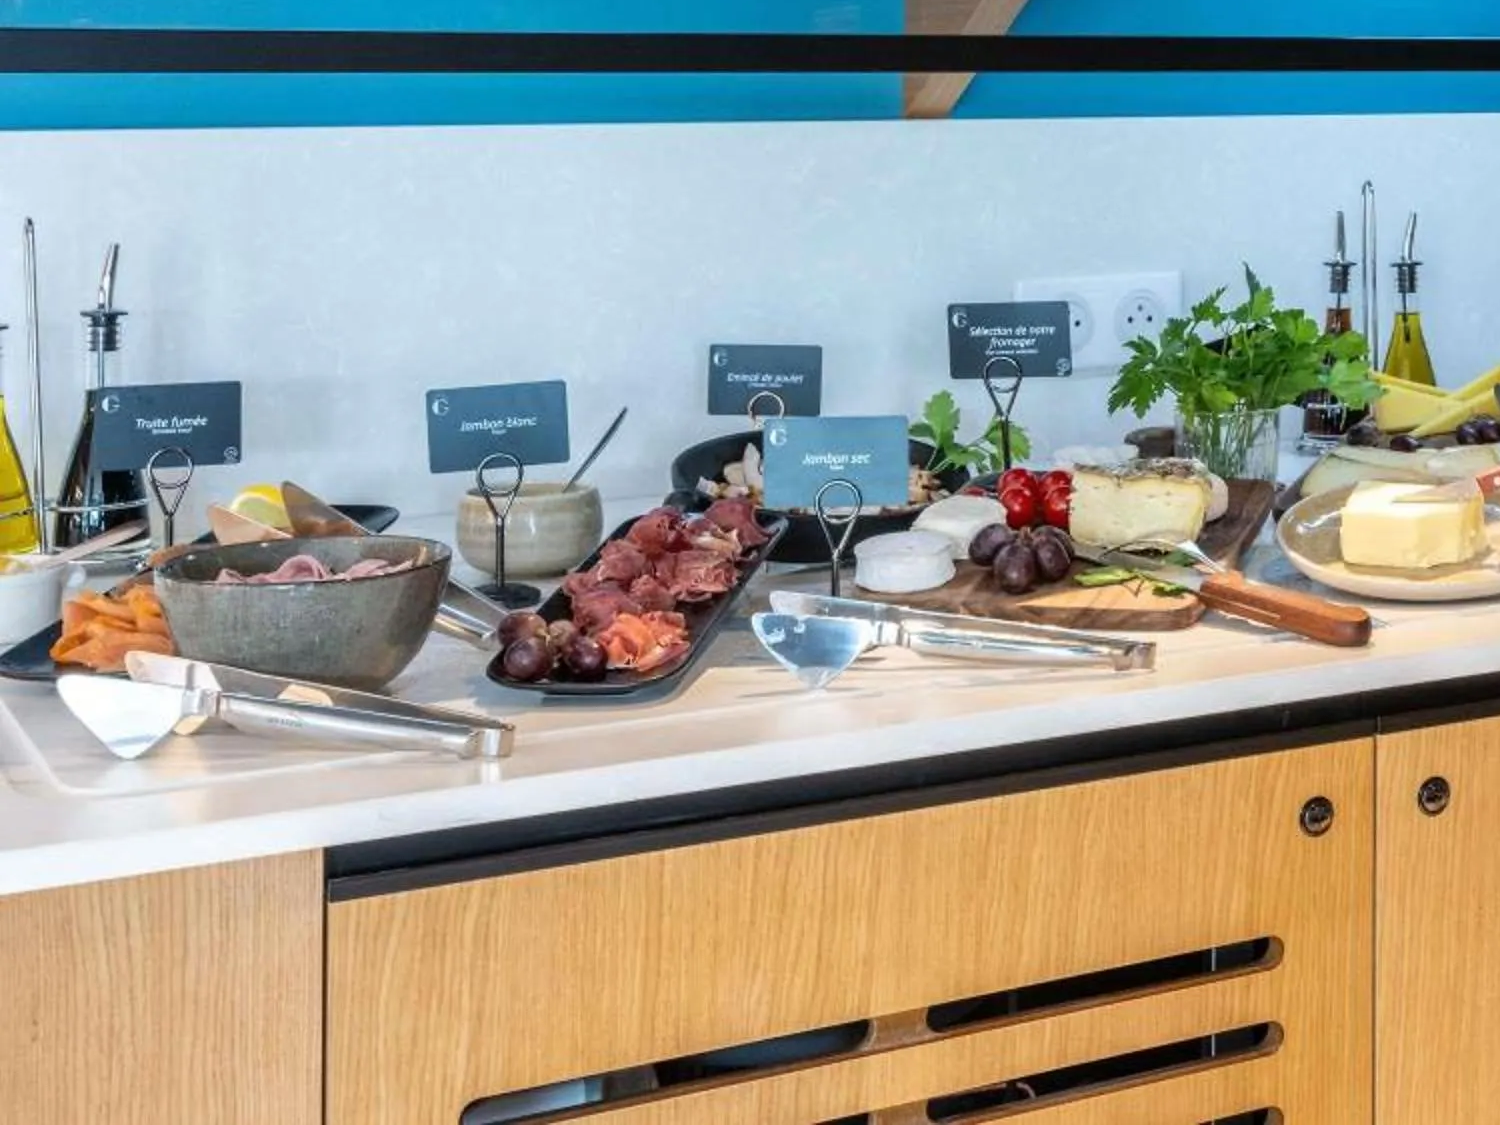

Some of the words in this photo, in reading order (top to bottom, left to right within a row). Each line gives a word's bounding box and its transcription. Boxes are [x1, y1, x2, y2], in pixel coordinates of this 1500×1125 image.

[969, 326, 1013, 336] Sélection
[1014, 326, 1027, 336] de
[988, 337, 1037, 349] fromager
[135, 417, 168, 429] Truite
[170, 415, 208, 428] fumée
[460, 418, 504, 432] Jambon
[506, 416, 538, 428] blanc
[801, 452, 848, 465] Jambon
[850, 453, 872, 464] sec
